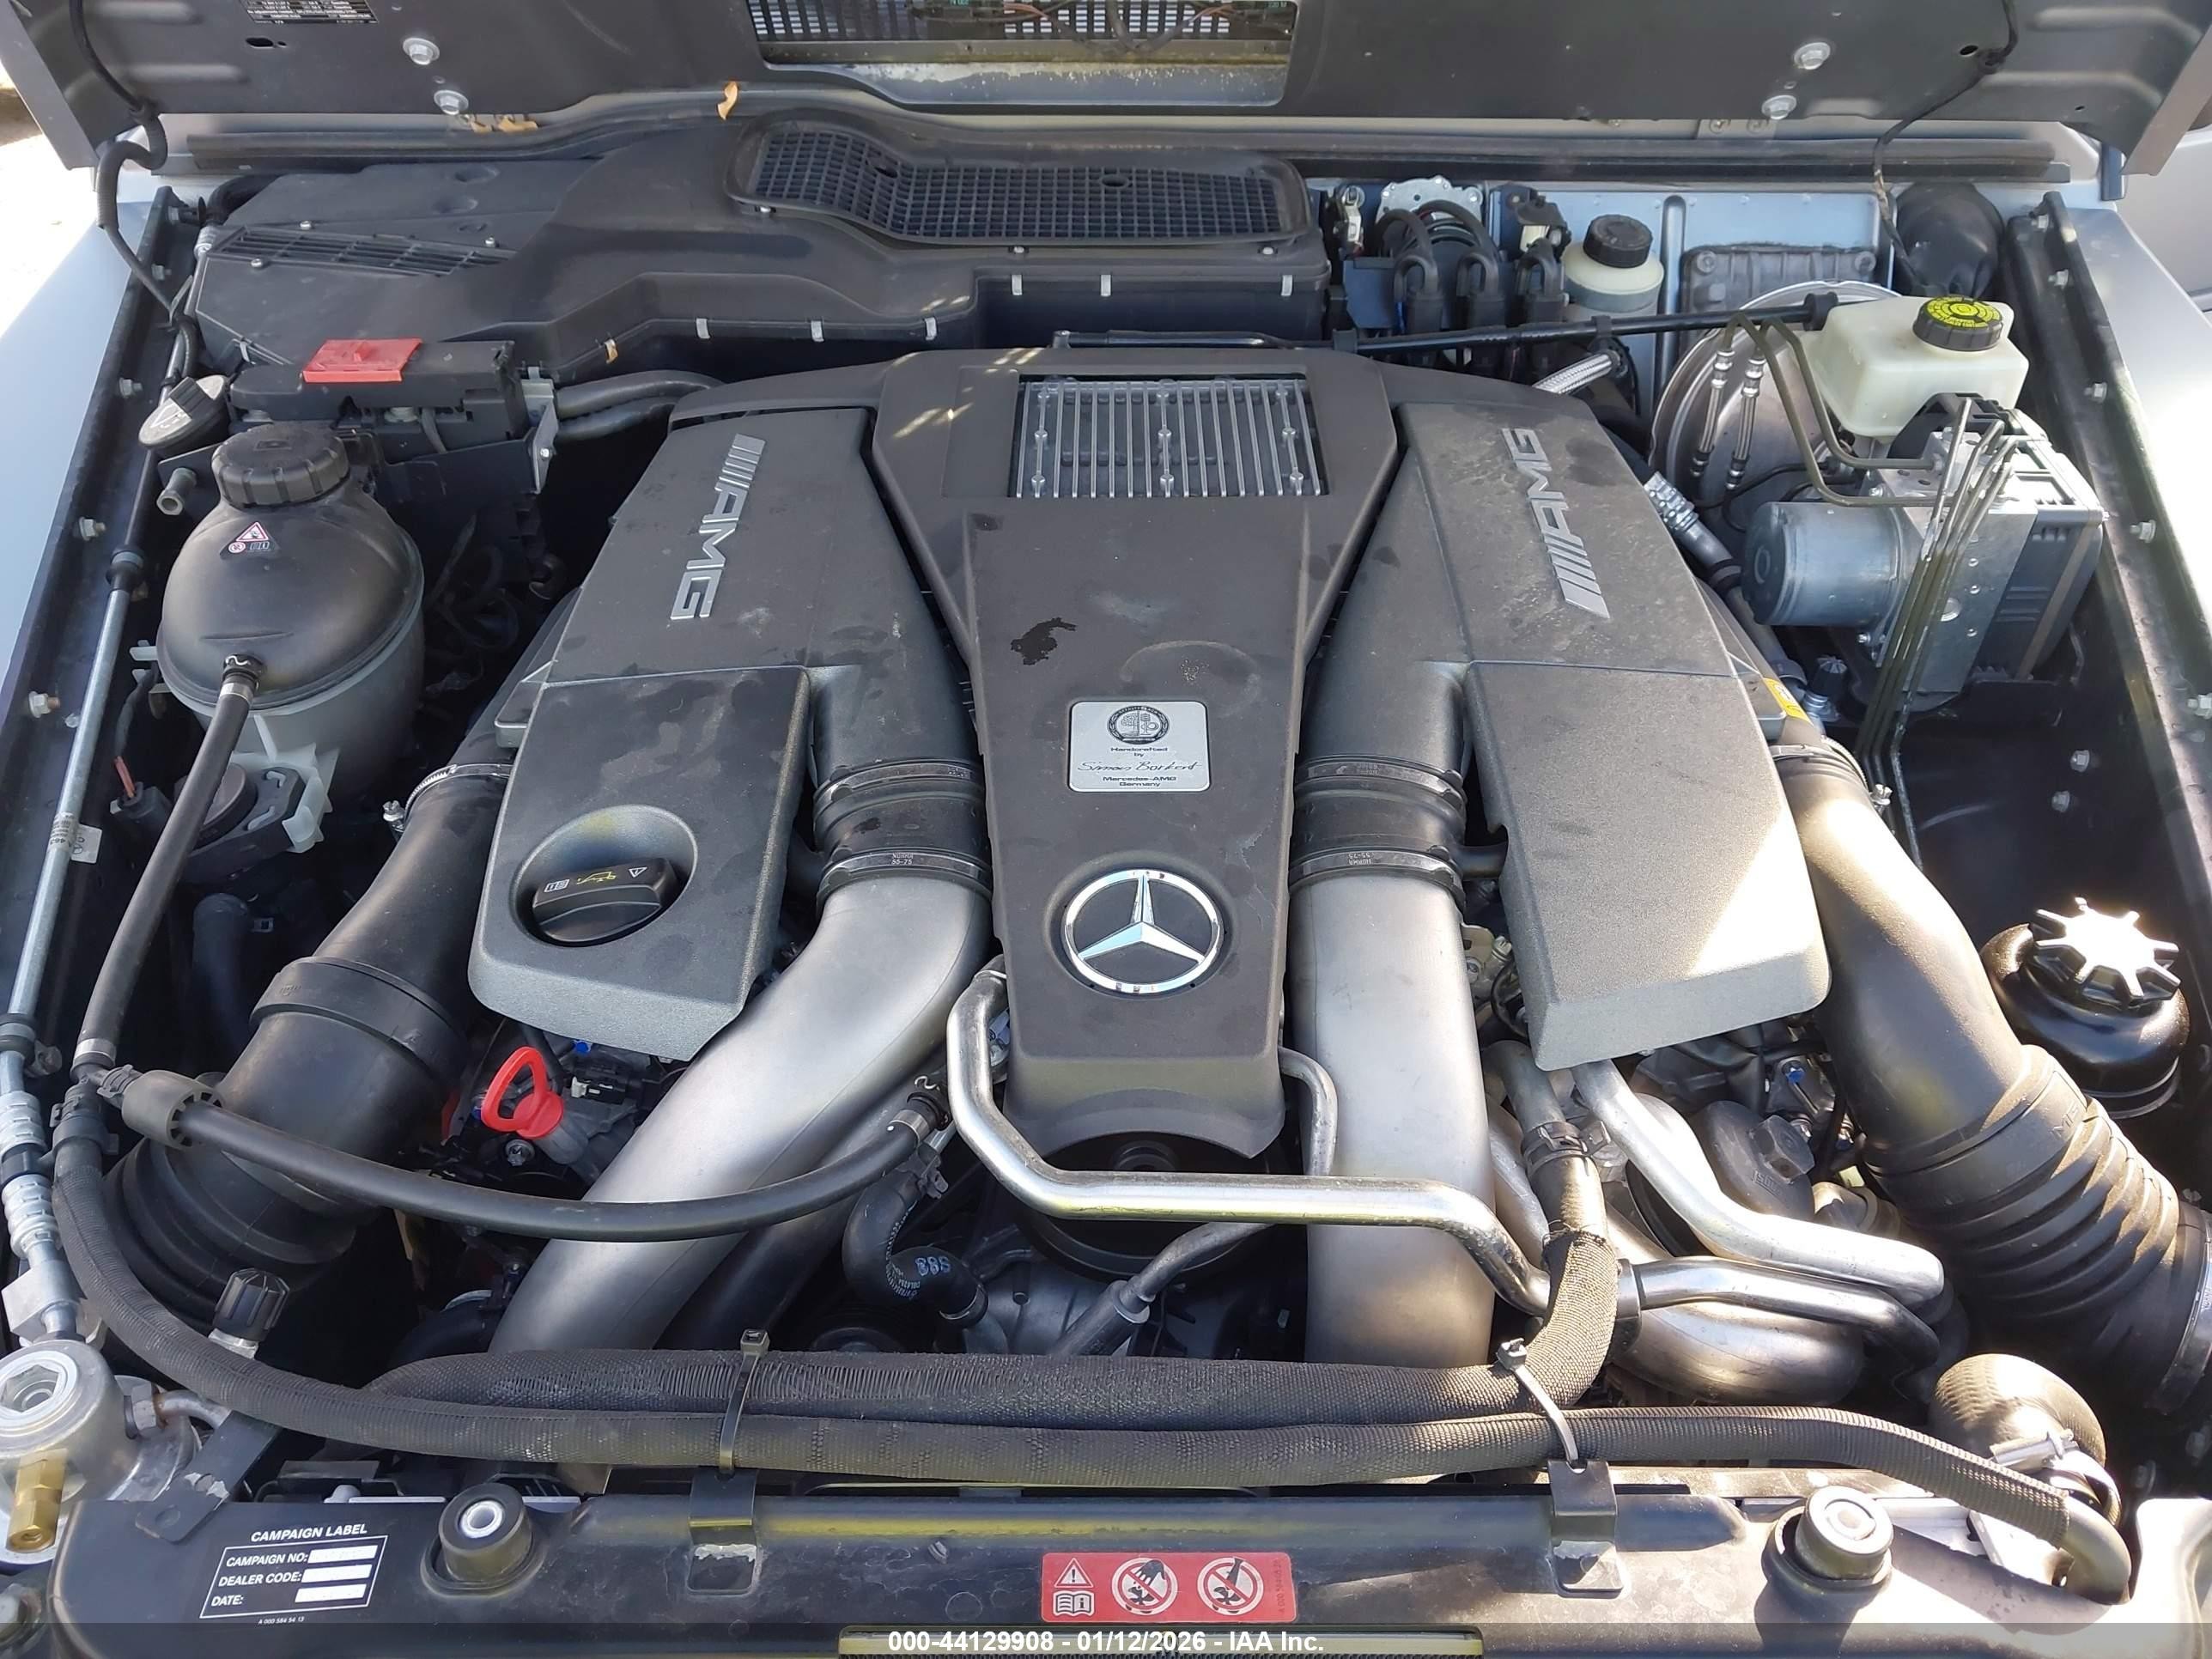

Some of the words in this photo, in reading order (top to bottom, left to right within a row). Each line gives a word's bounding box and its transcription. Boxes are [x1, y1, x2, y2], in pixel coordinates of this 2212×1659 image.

[671, 483, 747, 621] AMG
[251, 1527, 323, 1542] CAMPAIGN
[325, 1524, 368, 1535] LABEL
[226, 1554, 286, 1567] CAMPAIGN
[288, 1553, 308, 1563] NO:
[218, 1573, 263, 1587] DEALER
[265, 1571, 301, 1583] CODE:
[211, 1595, 244, 1607] DATE:
